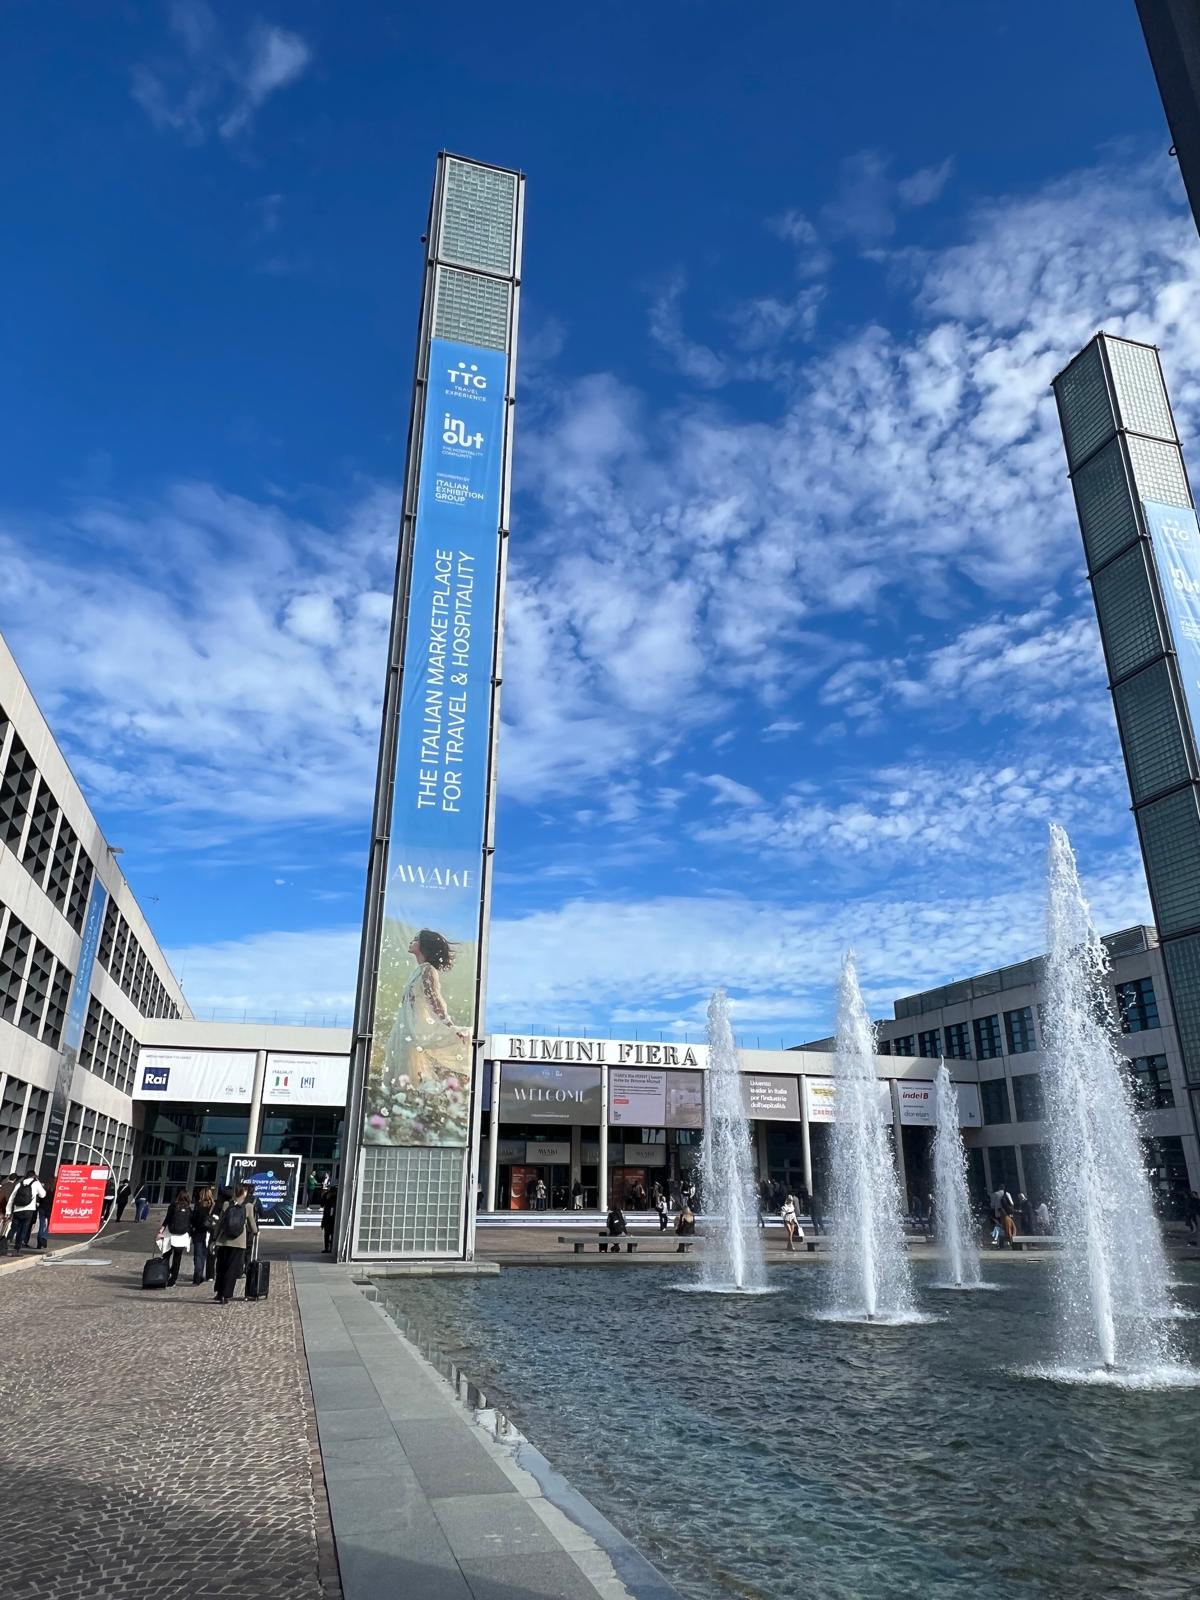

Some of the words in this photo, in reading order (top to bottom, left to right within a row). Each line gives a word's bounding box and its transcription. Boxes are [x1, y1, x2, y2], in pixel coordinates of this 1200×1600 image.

[447, 369, 487, 389] TTG
[445, 389, 487, 402] EXPERIENCE
[454, 385, 479, 395] TRAVEL
[444, 412, 466, 432] in
[442, 430, 485, 450] out
[436, 479, 469, 491] ITALIAN
[436, 485, 484, 500] EXHIBITION
[435, 492, 466, 503] GROUP
[426, 549, 453, 686] MARKETPLACE
[451, 550, 475, 667] HOSPITALITY
[450, 672, 468, 686] &
[420, 690, 444, 764] ITALIAN
[445, 691, 467, 765] TRAVEL
[417, 768, 438, 809] THE
[442, 770, 463, 812] FOR
[391, 864, 476, 888] AWAKE
[508, 1037, 608, 1063] RIMINI
[617, 1042, 699, 1067] FIERA
[144, 1073, 167, 1085] Rai
[513, 1087, 584, 1103] WELCOME
[234, 1159, 257, 1167] nexi
[60, 1207, 94, 1217] HeyLight
